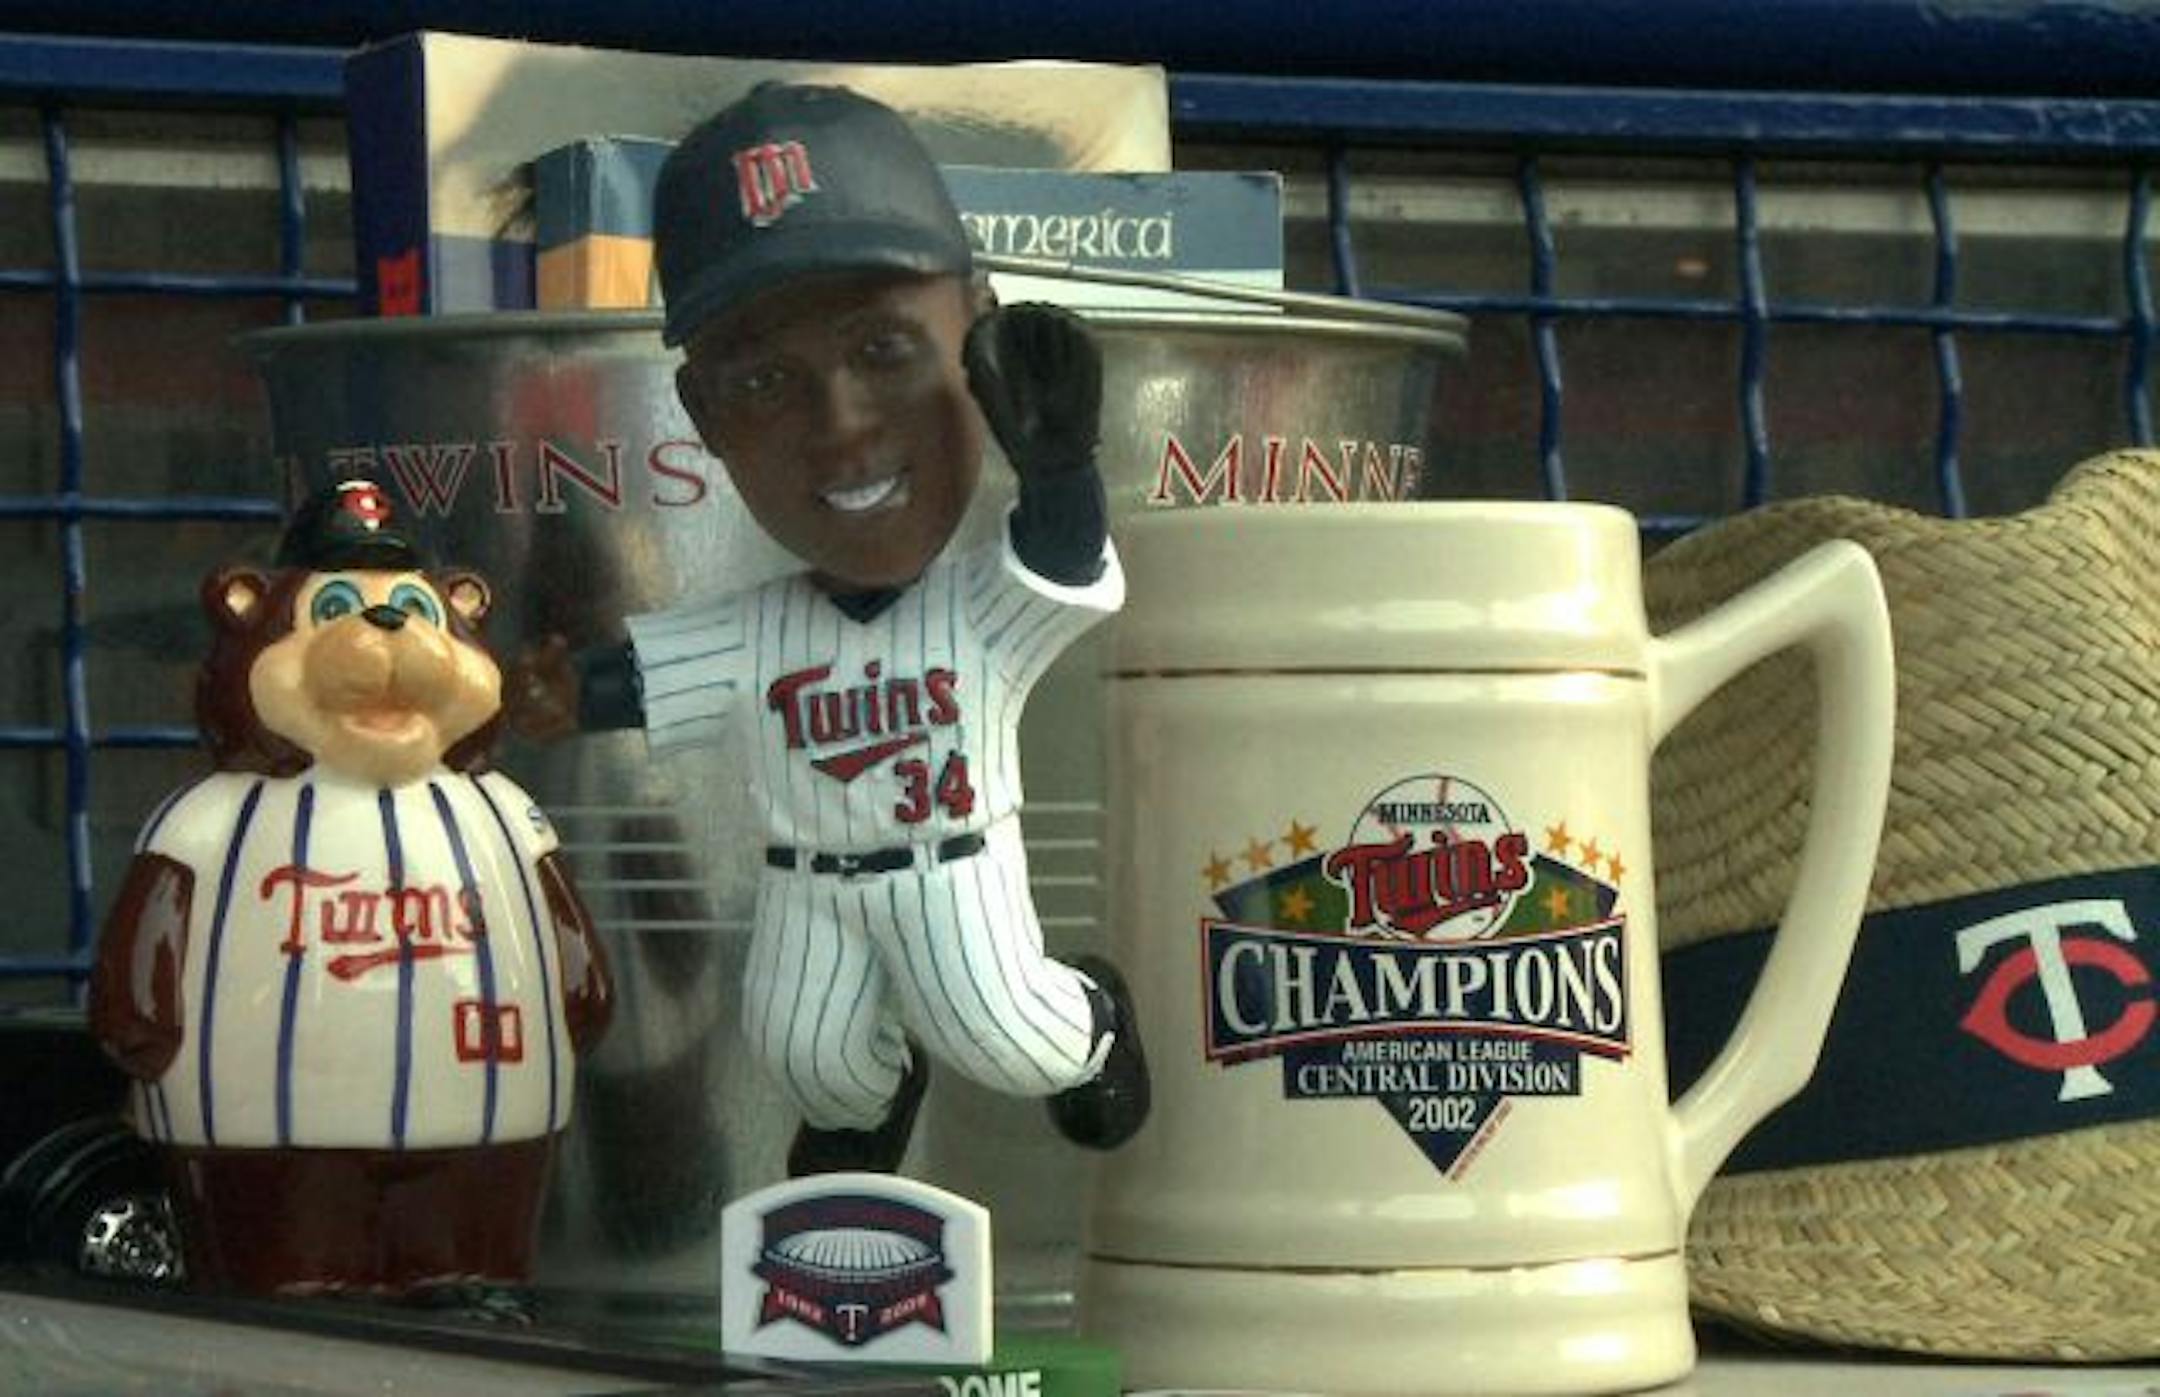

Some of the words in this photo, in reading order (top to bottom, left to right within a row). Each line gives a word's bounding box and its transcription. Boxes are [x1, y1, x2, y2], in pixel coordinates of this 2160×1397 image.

[767, 659, 959, 750] Twins
[894, 749, 975, 823] 34
[1376, 803, 1492, 823] MINNESOTA
[1327, 830, 1529, 930] Twins
[1218, 935, 1623, 1036] CHAMPIONS
[1298, 1063, 1439, 1094] CENTRAL
[1449, 1062, 1572, 1092] DIVISION
[1341, 1040, 1451, 1063] AMERICAN
[1456, 1040, 1533, 1061] LEAGUE
[1408, 1096, 1477, 1132] 2002
